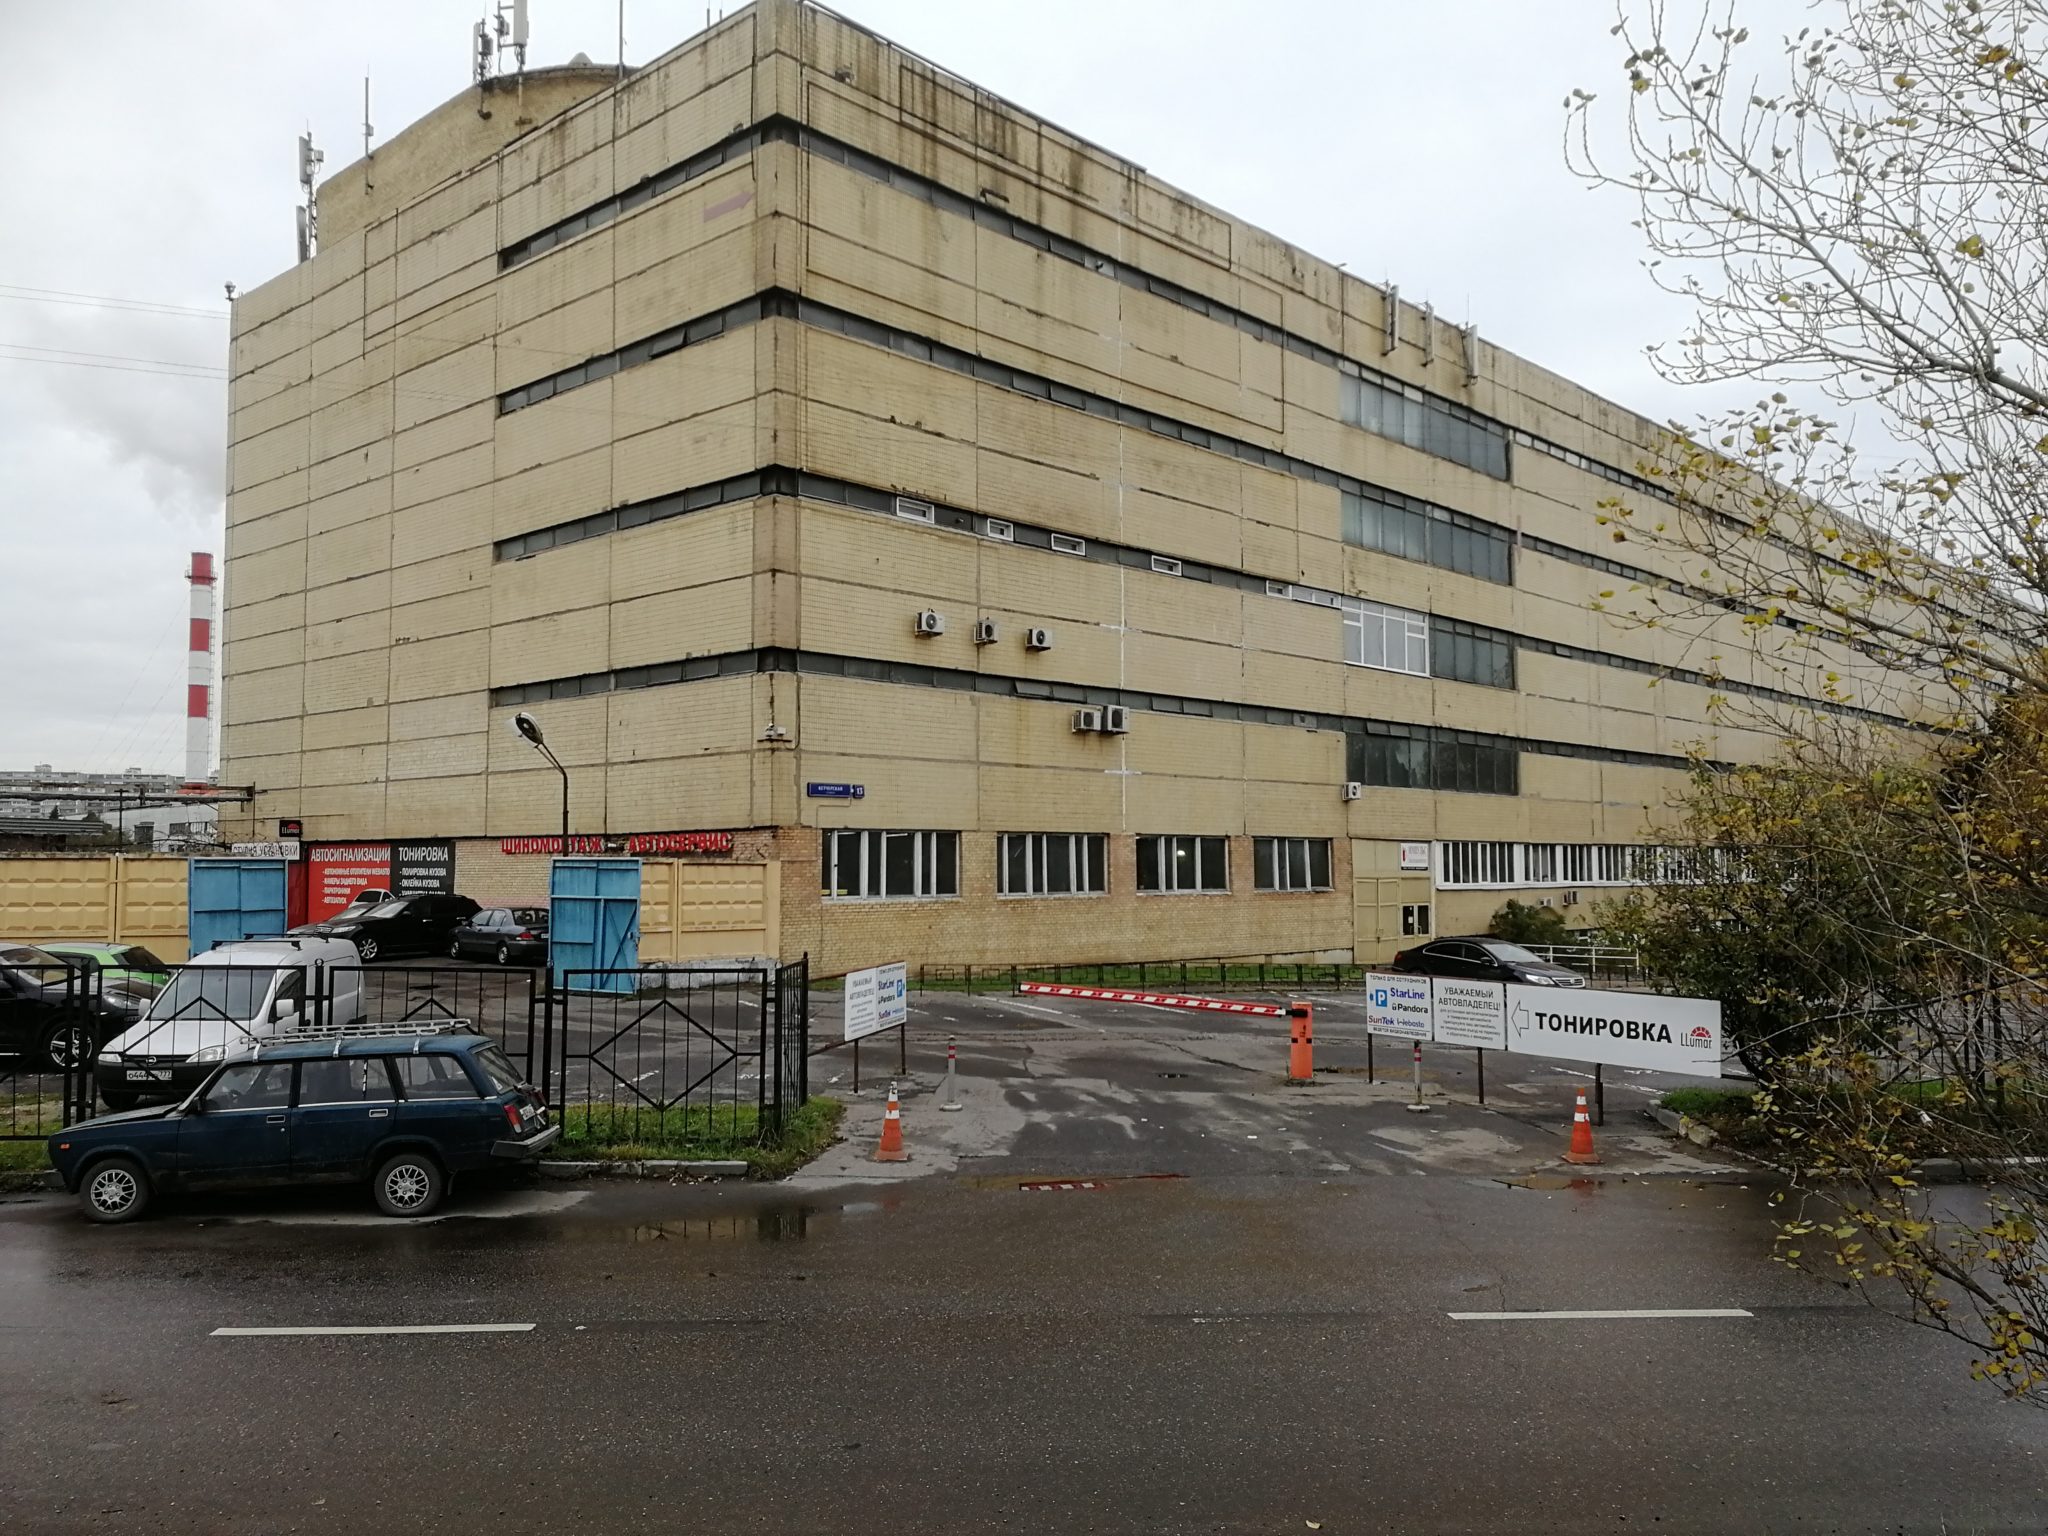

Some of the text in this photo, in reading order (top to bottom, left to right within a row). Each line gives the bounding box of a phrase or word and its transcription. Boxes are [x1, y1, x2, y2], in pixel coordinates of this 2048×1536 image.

[628, 832, 732, 852] АВТОСЕРВИС
[311, 847, 391, 863] АВТОСИГНАЛИЗАЦИИ
[399, 846, 449, 861] ТОНИРОВКА
[1390, 987, 1425, 1000] StarLine
[1444, 986, 1494, 999] УВАЖАЕМЫЙ
[1397, 1003, 1429, 1014] Pandora
[1438, 997, 1501, 1011] АВТОВЛАДЕЛЕЦ!
[1368, 1015, 1394, 1026] SunTek
[1535, 1011, 1673, 1044] ТОНИРОВКА
